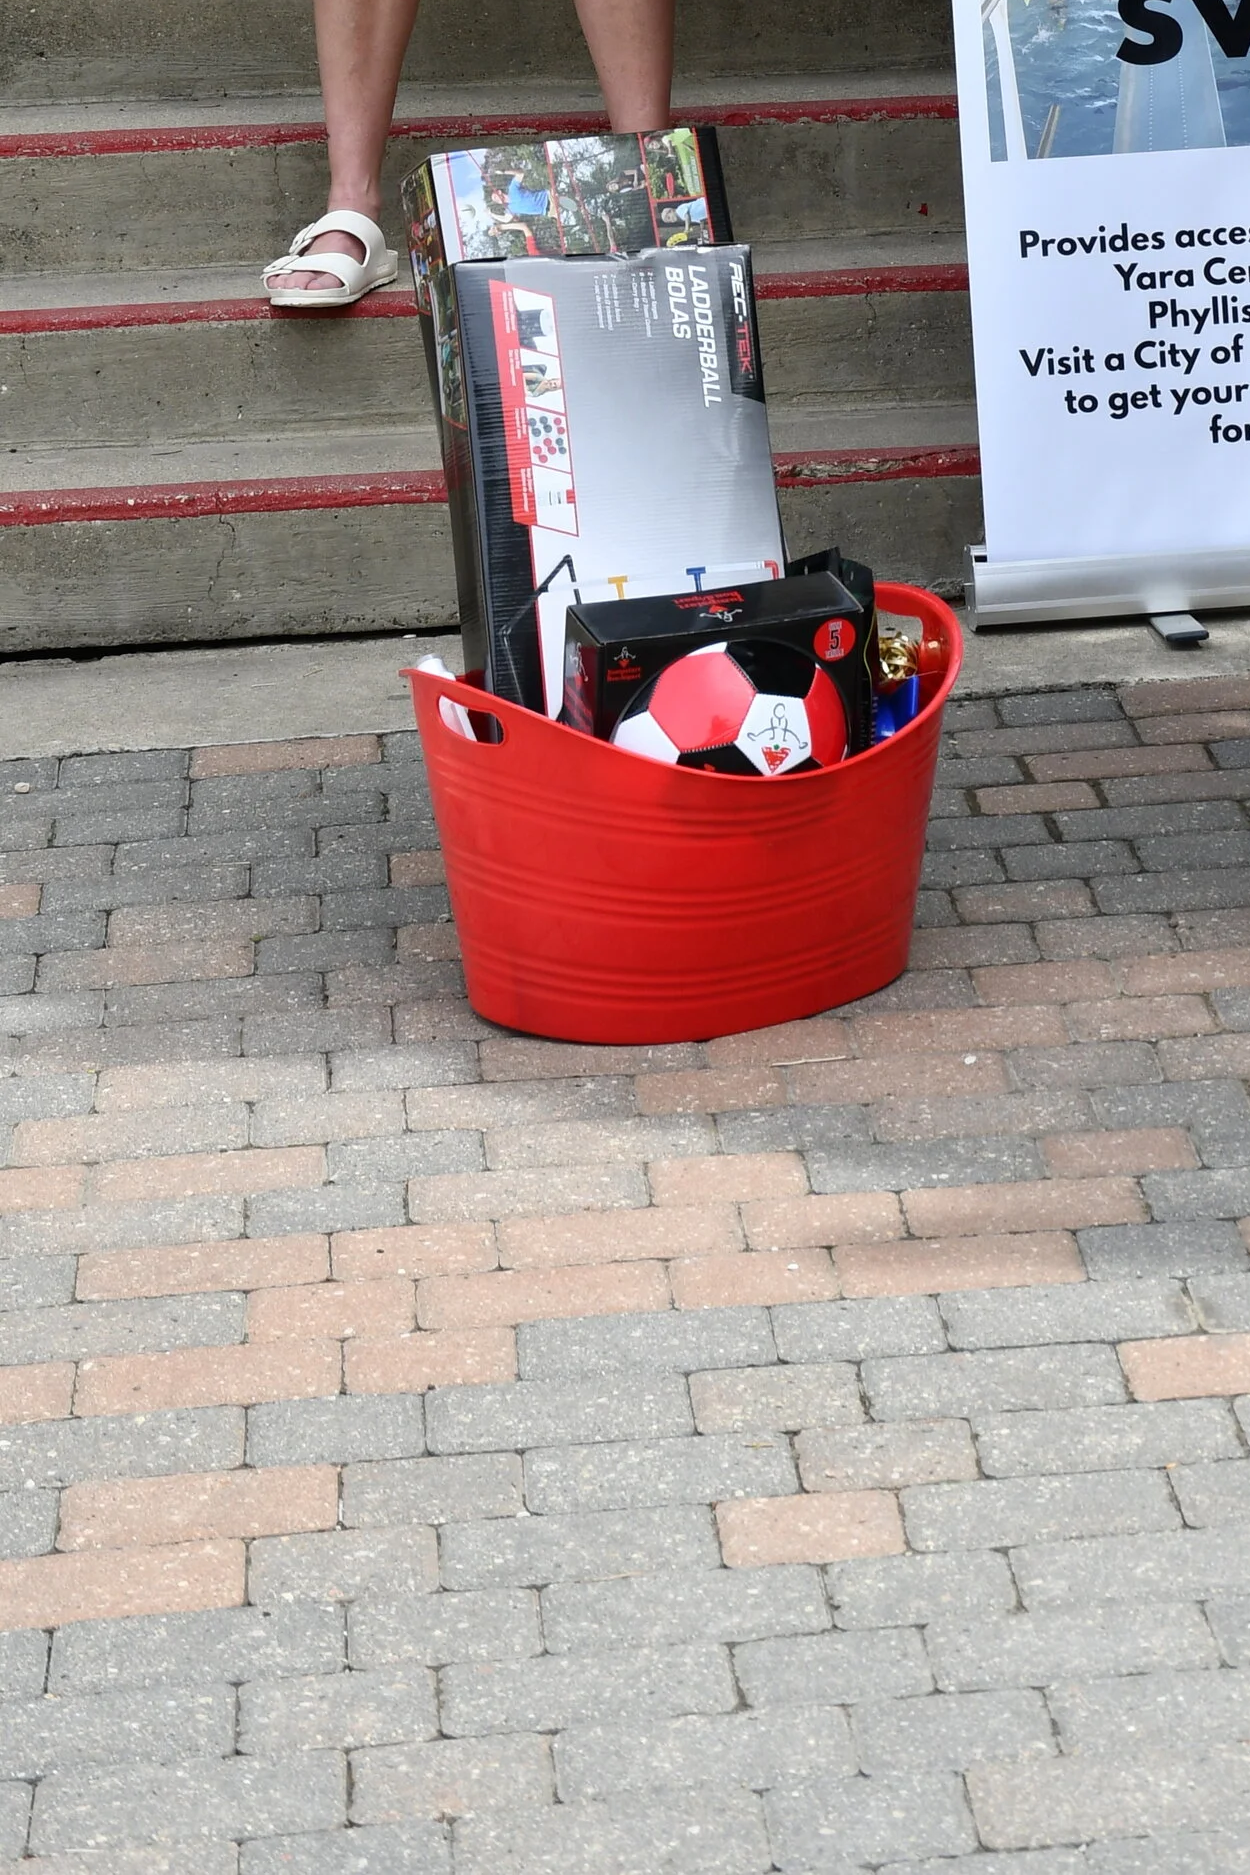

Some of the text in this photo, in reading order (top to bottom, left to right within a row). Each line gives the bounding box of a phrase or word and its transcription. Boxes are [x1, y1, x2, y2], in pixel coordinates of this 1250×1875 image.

[1019, 222, 1165, 258] Provides
[1113, 262, 1194, 292] Yara
[665, 266, 692, 340] BOLAS
[729, 261, 753, 374] REC-TEK
[688, 264, 722, 408] LADDERBALL
[1019, 345, 1096, 377] Visit
[1104, 352, 1125, 372] a
[1134, 340, 1200, 375] City
[1210, 333, 1244, 365] of
[1064, 389, 1099, 415] to
[1108, 383, 1162, 420] get
[1170, 382, 1249, 415] your
[829, 632, 841, 650] 5
